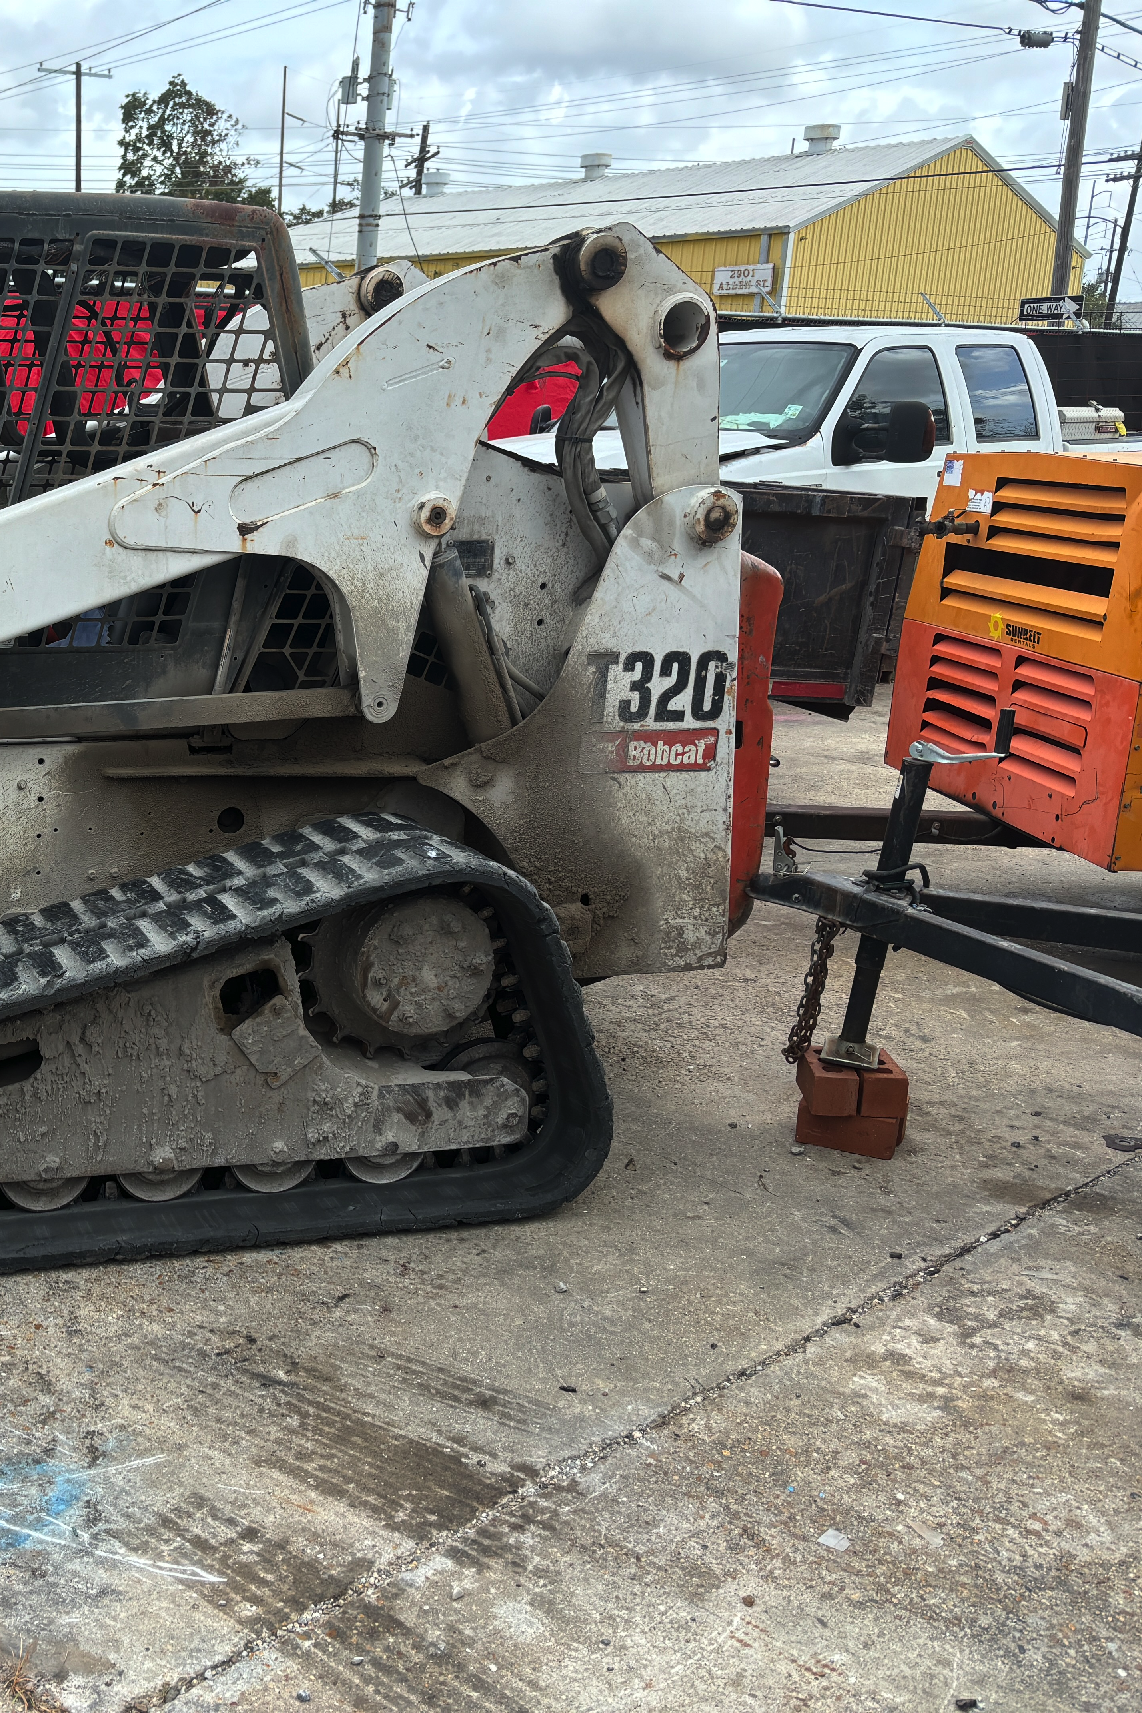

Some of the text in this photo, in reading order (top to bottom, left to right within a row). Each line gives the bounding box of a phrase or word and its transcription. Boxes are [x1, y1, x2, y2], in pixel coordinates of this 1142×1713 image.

[730, 268, 756, 279] 2901
[717, 280, 752, 291] ALLEN
[1026, 303, 1064, 314] ONE WAY
[1006, 623, 1042, 645] SUNBELT
[1010, 637, 1036, 650] RENTALS
[587, 650, 729, 723] T320
[627, 740, 706, 766] Bobcat
